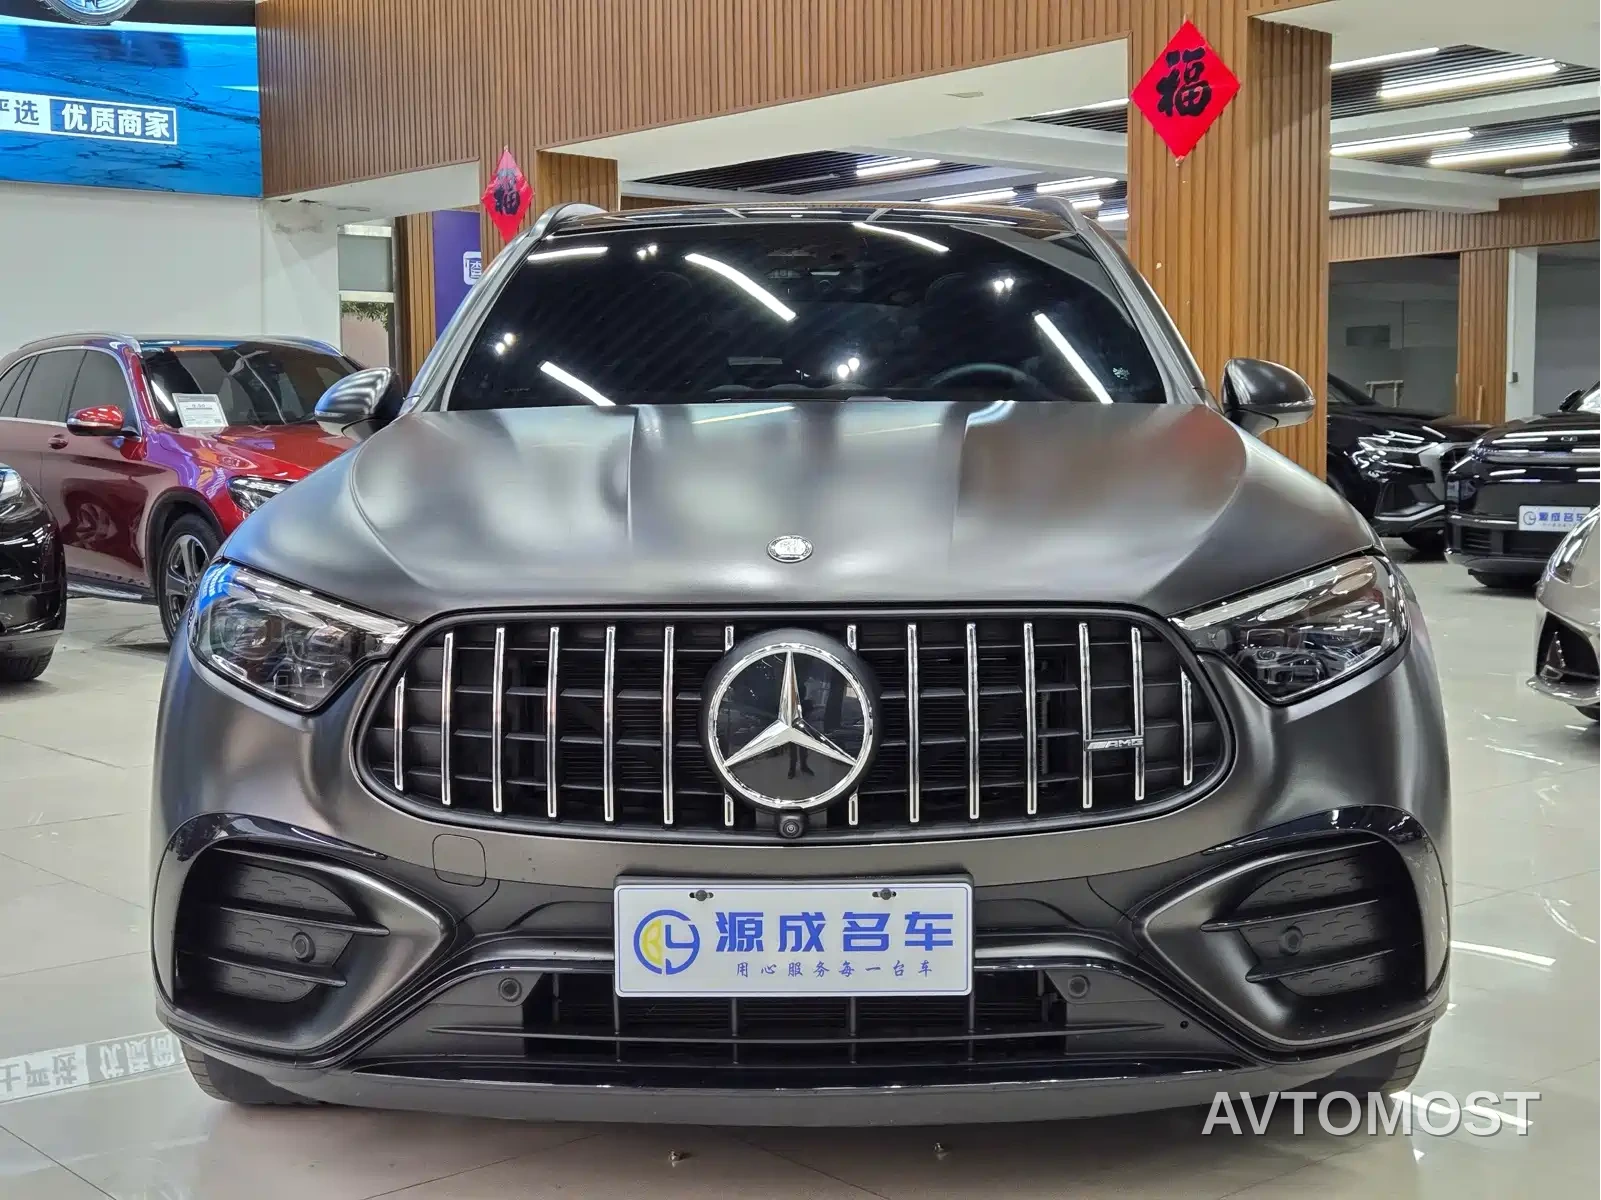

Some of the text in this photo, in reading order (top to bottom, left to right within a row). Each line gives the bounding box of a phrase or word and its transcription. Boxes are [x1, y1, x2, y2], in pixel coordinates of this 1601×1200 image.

[1156, 47, 1212, 117] 福
[61, 103, 170, 139] 优质商家
[1104, 738, 1143, 748] AMG
[715, 911, 953, 953] 源成名车
[735, 959, 933, 978] 用心服务每一台车
